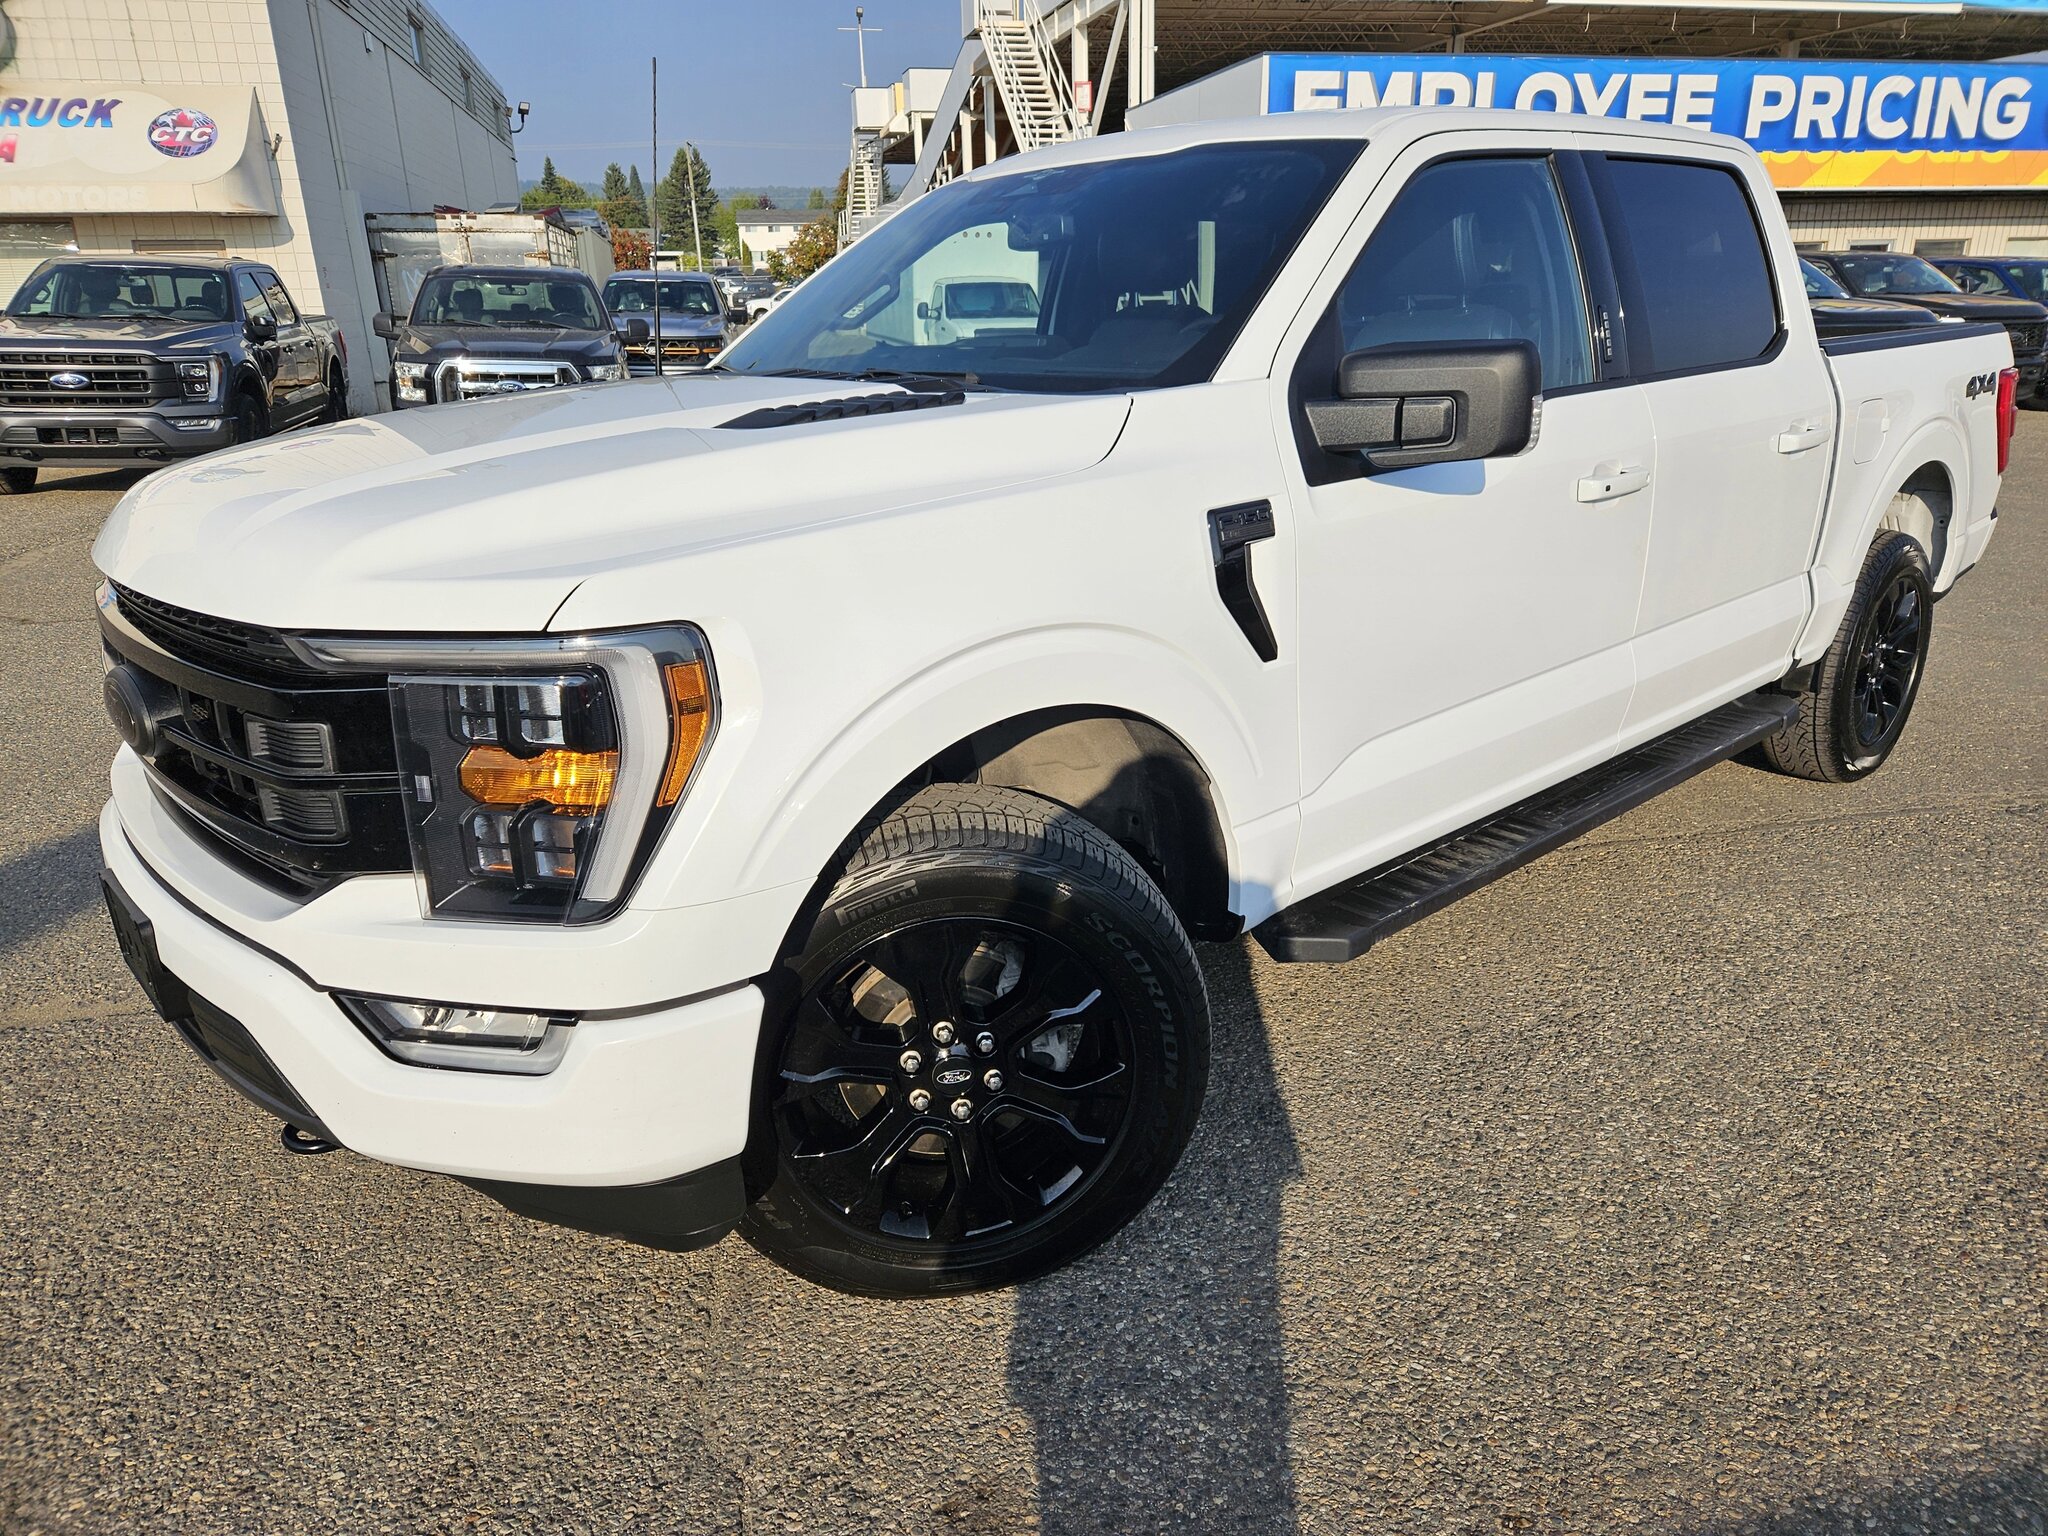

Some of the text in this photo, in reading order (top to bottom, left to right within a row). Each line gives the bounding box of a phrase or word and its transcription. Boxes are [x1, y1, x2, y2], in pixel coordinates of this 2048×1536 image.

[1745, 75, 2033, 140] PRICING
[150, 126, 213, 142] CTC
[9, 185, 149, 209] MOTORS
[1085, 912, 1179, 1090] SCORPION
